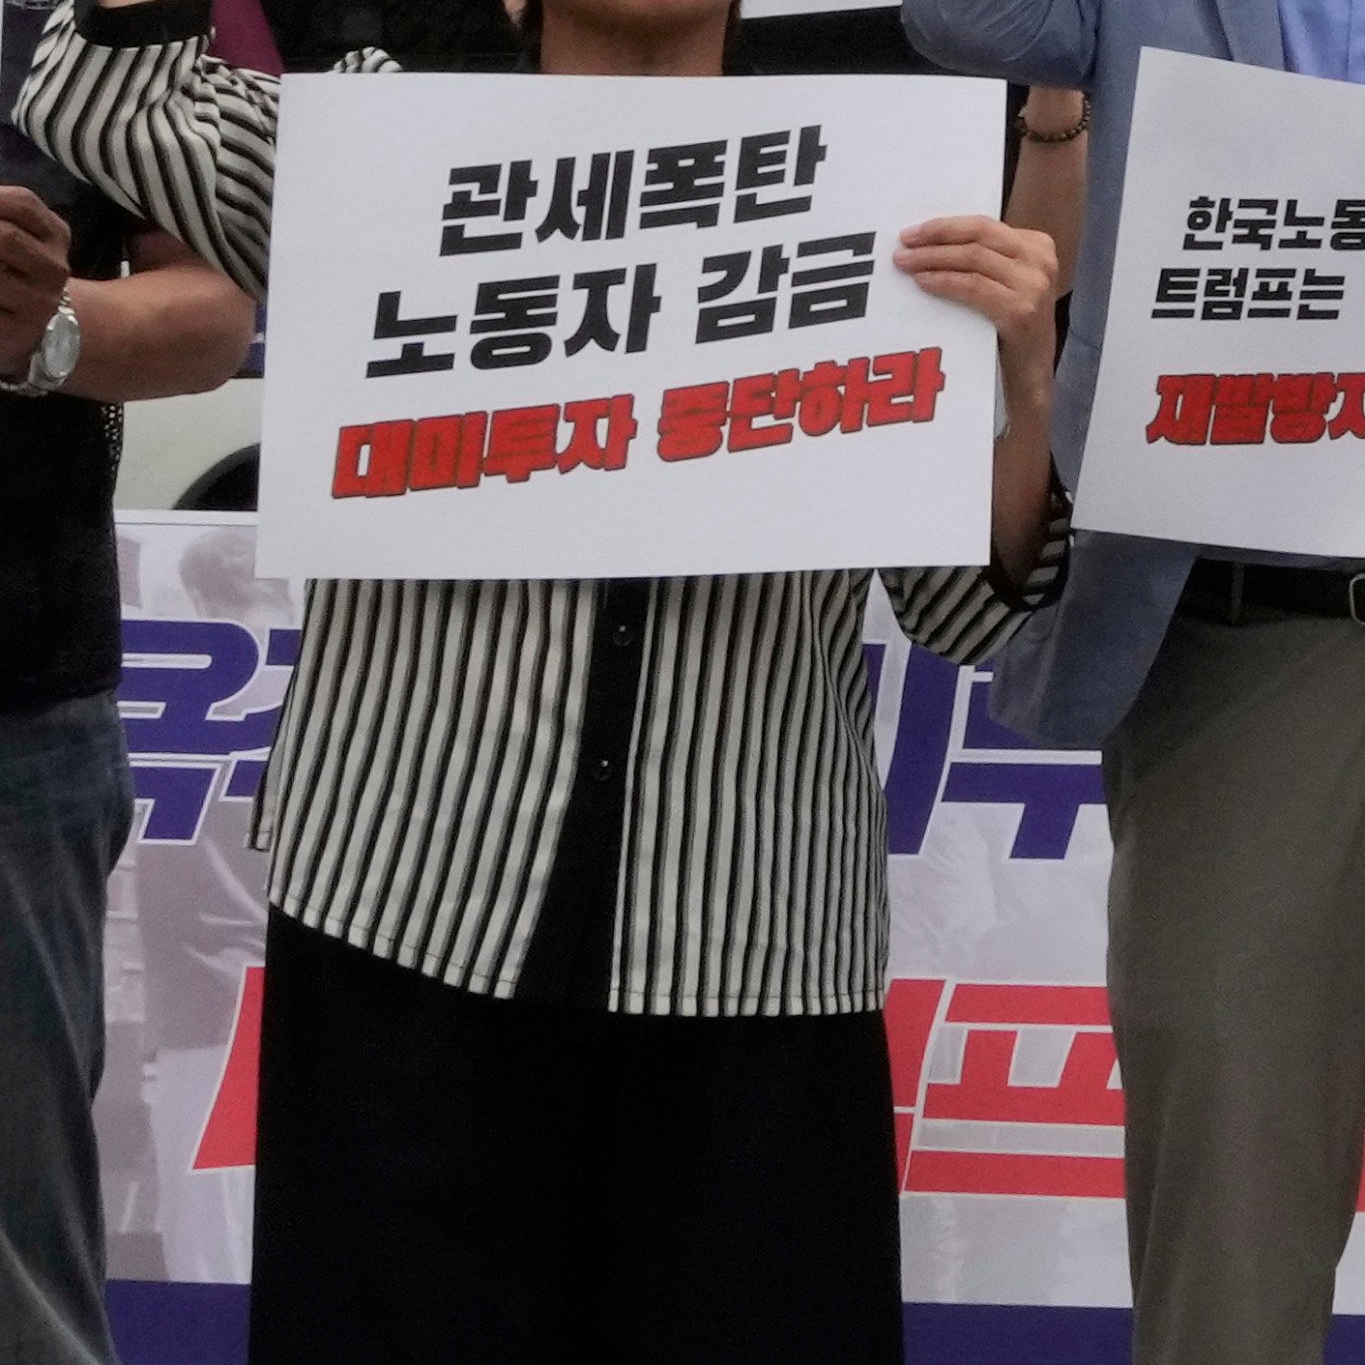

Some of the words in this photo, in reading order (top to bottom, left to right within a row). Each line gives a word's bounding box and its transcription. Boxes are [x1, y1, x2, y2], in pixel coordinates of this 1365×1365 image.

[439, 124, 828, 257] 관세폭탄
[366, 263, 661, 379] 노동자
[696, 231, 877, 344] 감금
[1151, 266, 1345, 321] 트럼프는
[331, 394, 637, 499] 대미투자
[656, 347, 946, 464] 중단하라
